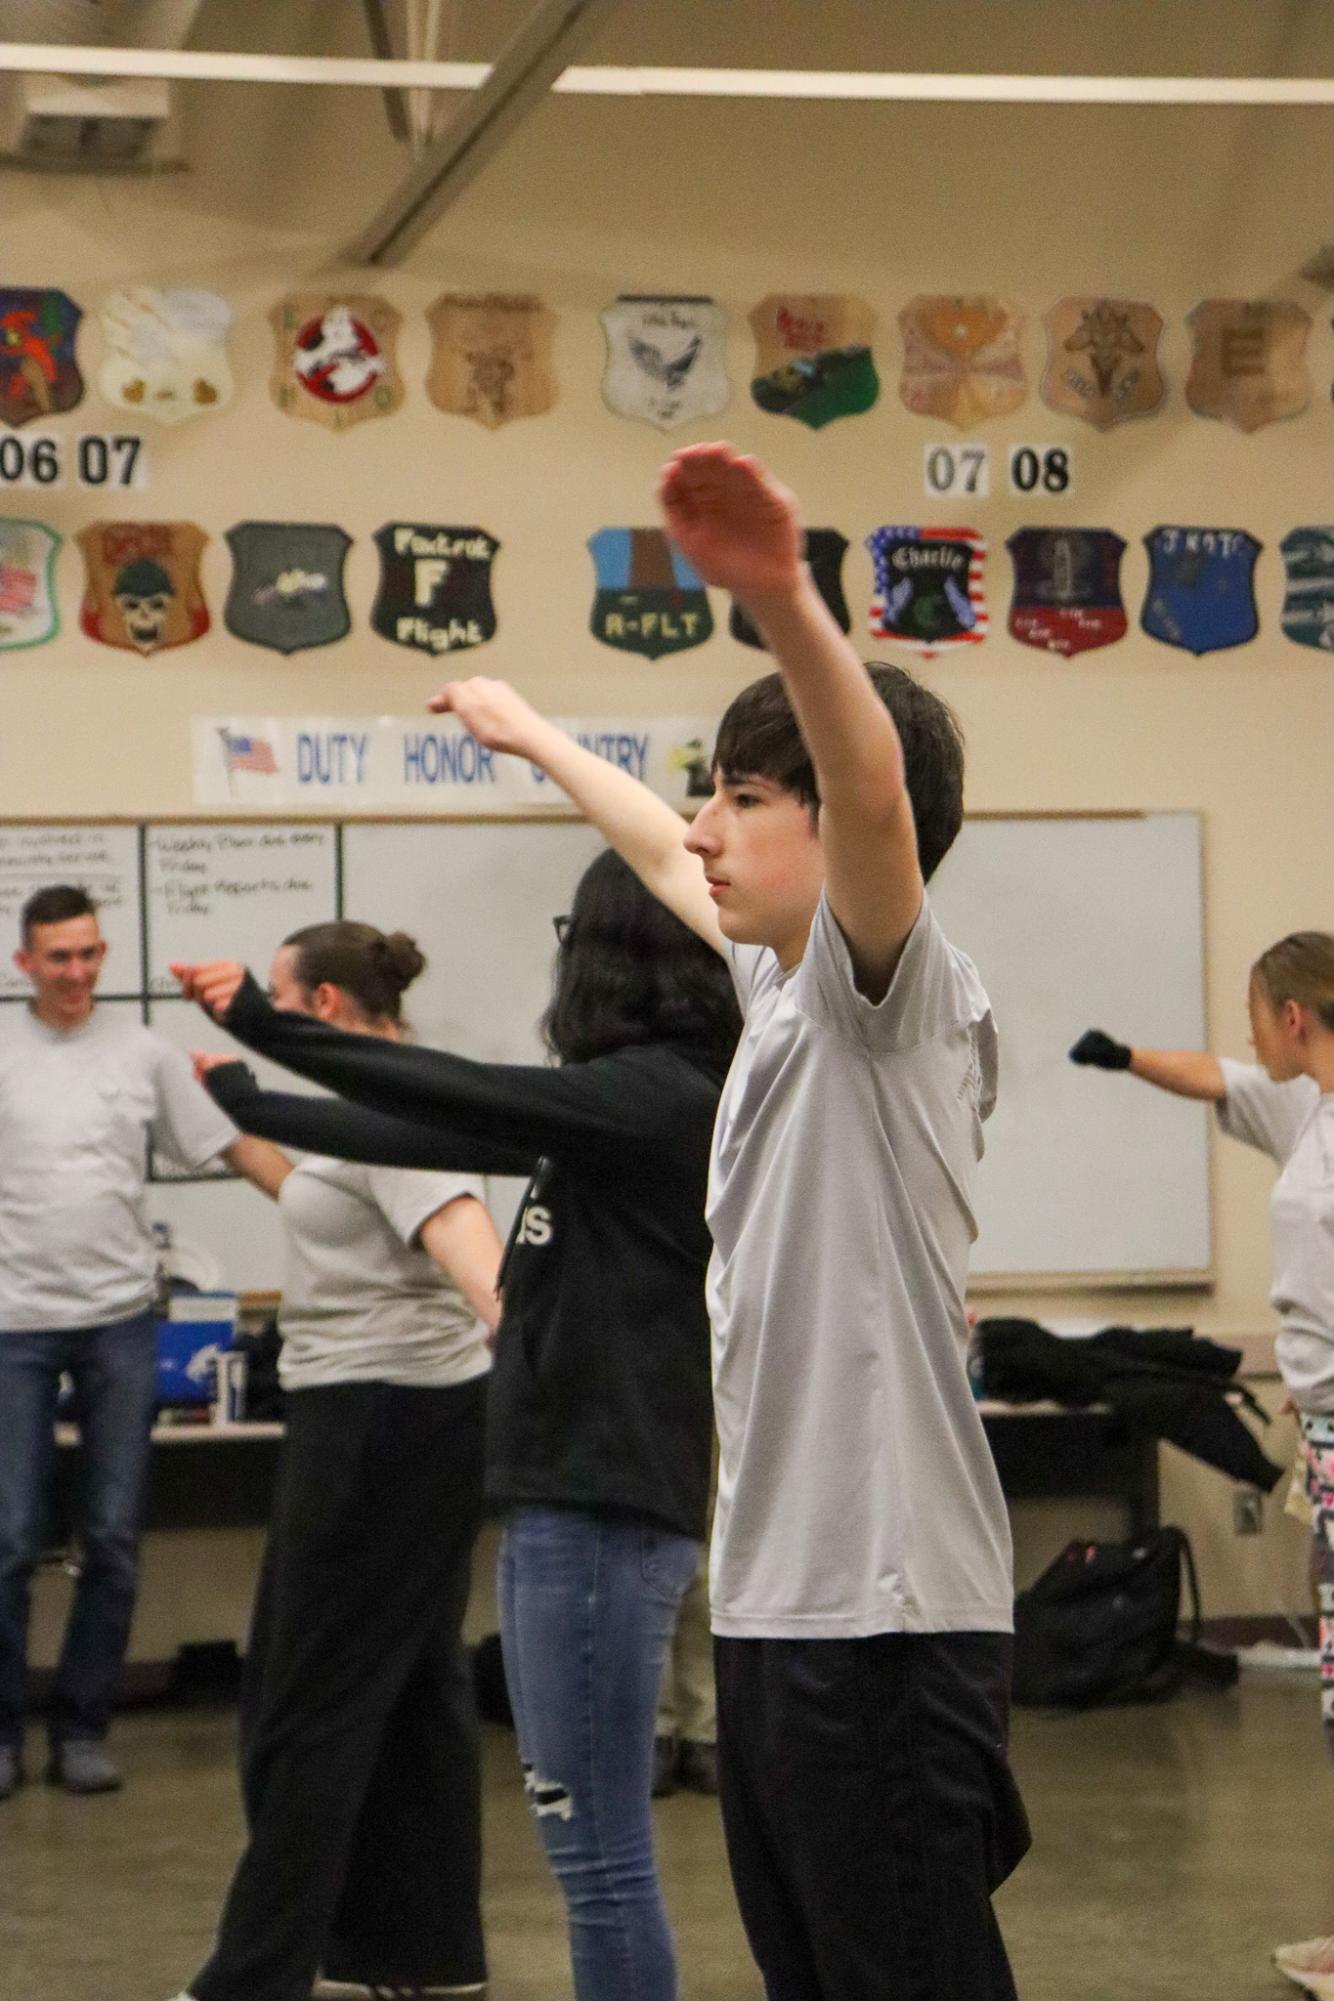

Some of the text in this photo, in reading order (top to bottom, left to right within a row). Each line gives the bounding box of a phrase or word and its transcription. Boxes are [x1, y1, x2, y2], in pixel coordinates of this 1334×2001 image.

[0, 435, 140, 484] 06 07
[927, 447, 1069, 492] 07 08
[891, 545, 964, 570] Charlie
[414, 558, 448, 607] F
[396, 617, 482, 651] Flight
[298, 733, 367, 783] DUTY
[403, 733, 494, 783] HONOR
